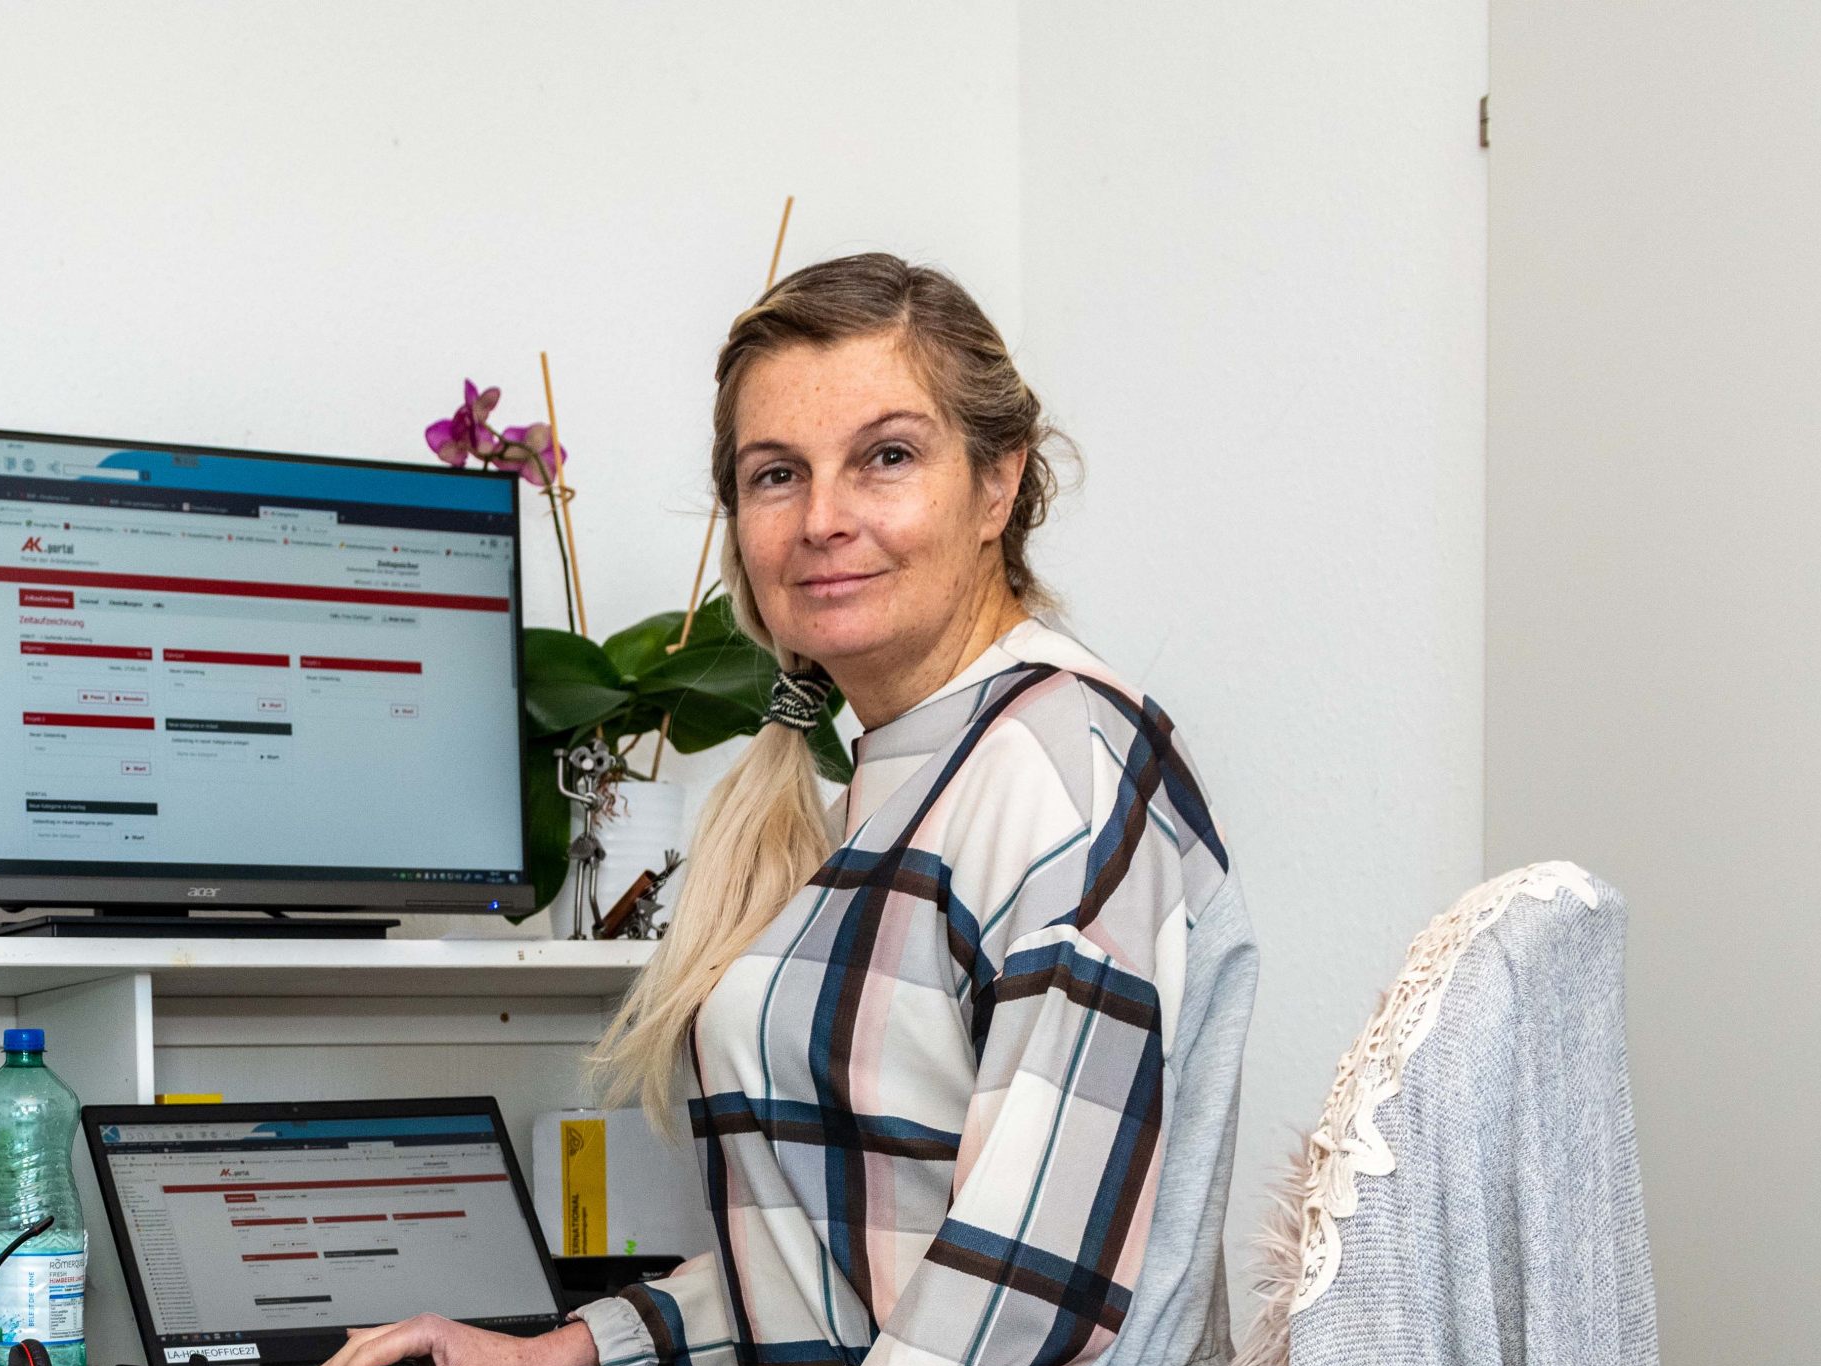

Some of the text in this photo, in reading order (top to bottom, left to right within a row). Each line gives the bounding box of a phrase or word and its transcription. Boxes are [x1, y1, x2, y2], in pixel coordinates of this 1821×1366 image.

[21, 537, 43, 552] AK
[19, 615, 85, 629] Zeitaufzeichnung
[187, 886, 221, 898] acer
[571, 1193, 580, 1254] ERNATIONAL
